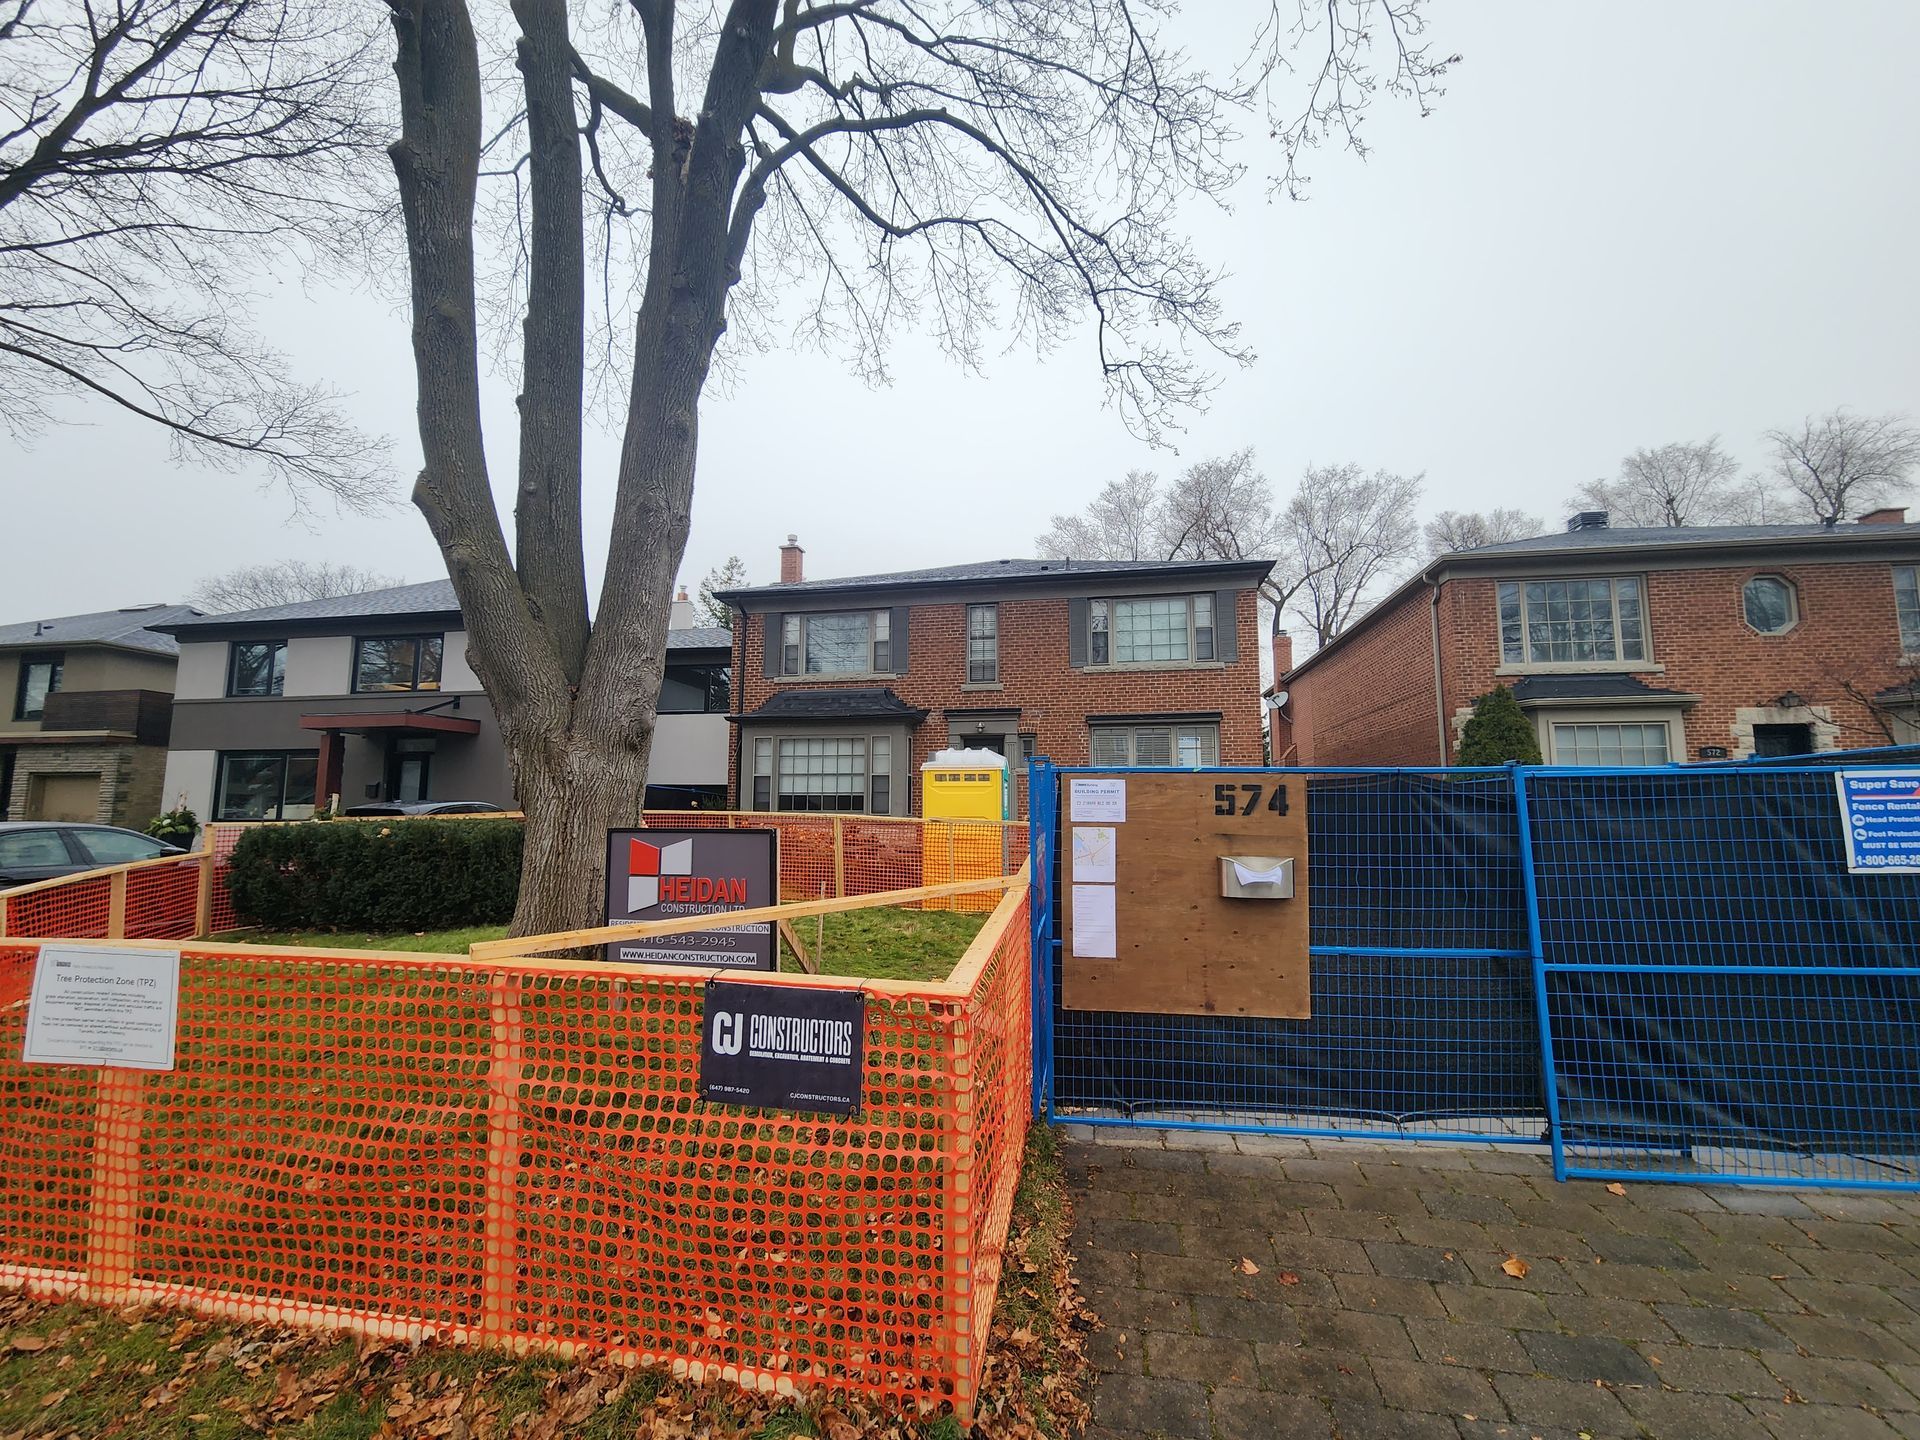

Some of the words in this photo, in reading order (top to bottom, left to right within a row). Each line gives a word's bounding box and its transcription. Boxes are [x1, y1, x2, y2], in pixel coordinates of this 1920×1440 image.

[1849, 780, 1888, 790] Super
[1889, 779, 1920, 789] Save
[1215, 784, 1289, 816] 574
[1852, 802, 1885, 811] Fence
[660, 876, 747, 903] HEIDAN
[660, 903, 727, 914] CONSTRUCTION
[640, 934, 737, 947] 416-543-2945
[621, 950, 756, 964] WWW.HEIDANCONSTRUCTION.COM
[56, 974, 72, 983] Tree
[75, 975, 114, 985] Protection
[116, 976, 135, 986] Zone
[136, 977, 157, 989] (TPZ)
[712, 1011, 744, 1056] CJ
[750, 1014, 852, 1056] CONSTRUCTORS
[709, 1084, 724, 1092] (647)
[789, 1092, 850, 1103] CJCONSTRUCTORS.CA
